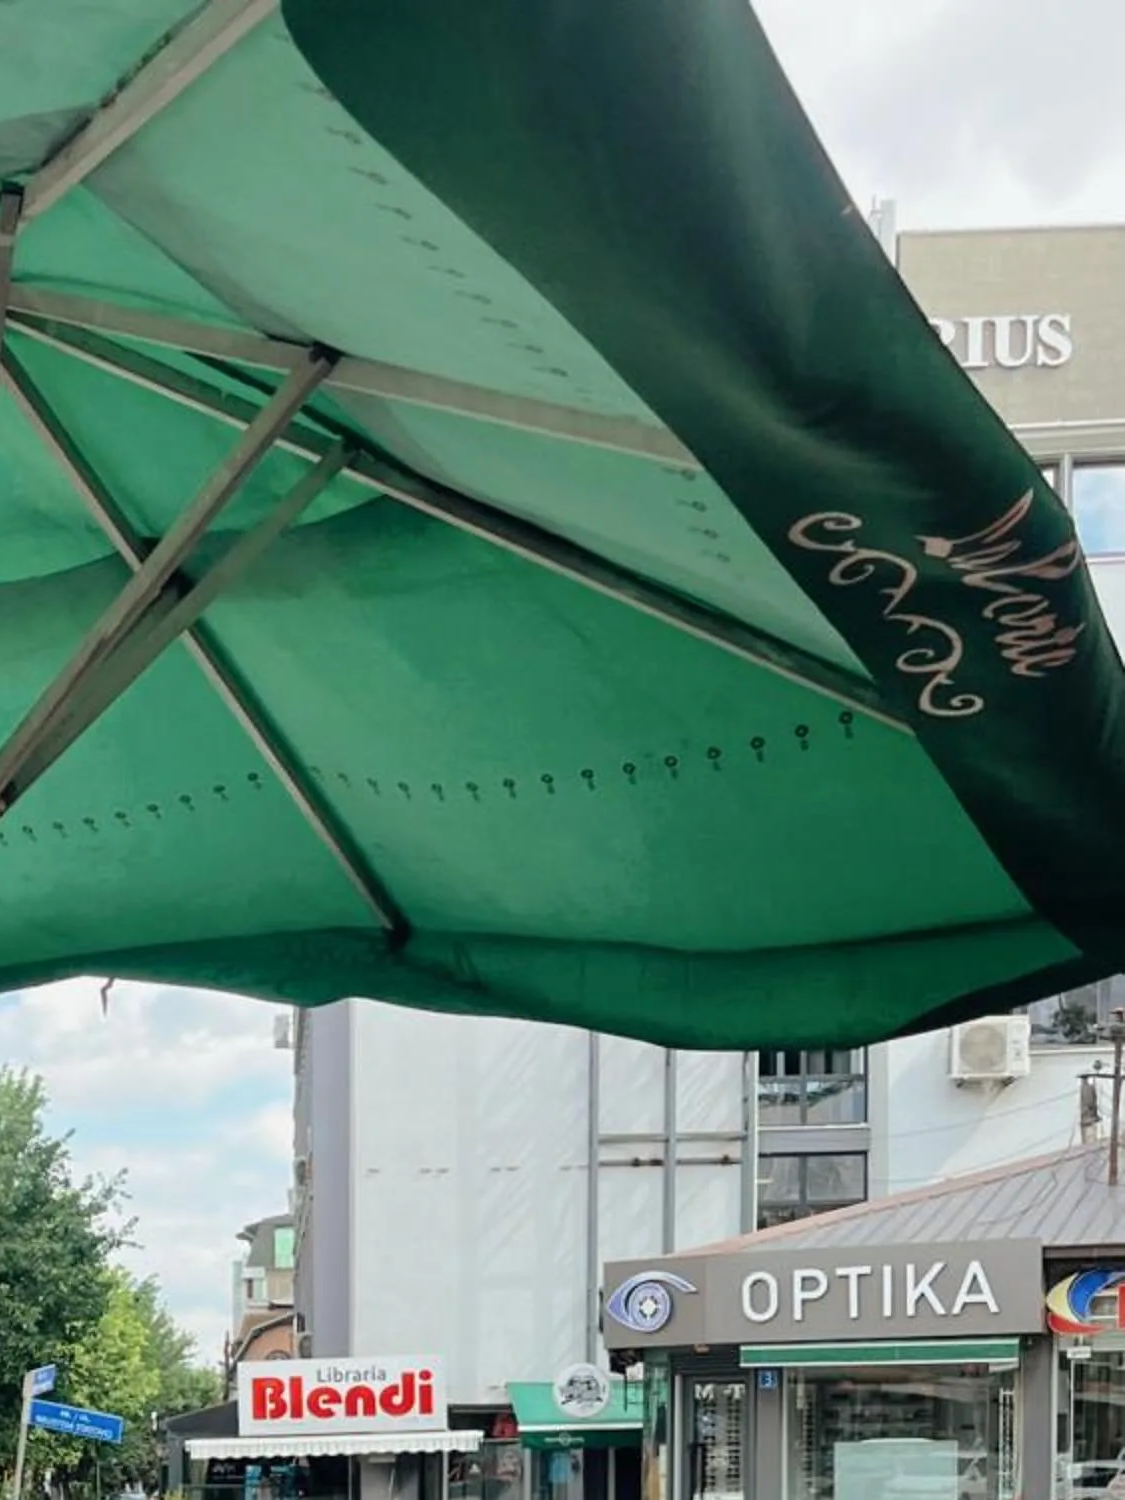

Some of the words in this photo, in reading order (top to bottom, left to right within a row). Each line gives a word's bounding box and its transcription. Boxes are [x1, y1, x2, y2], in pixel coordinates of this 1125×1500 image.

[742, 1260, 1001, 1323] OPTIKA
[252, 1369, 434, 1420] Blendi
[316, 1366, 387, 1383] Libraria
